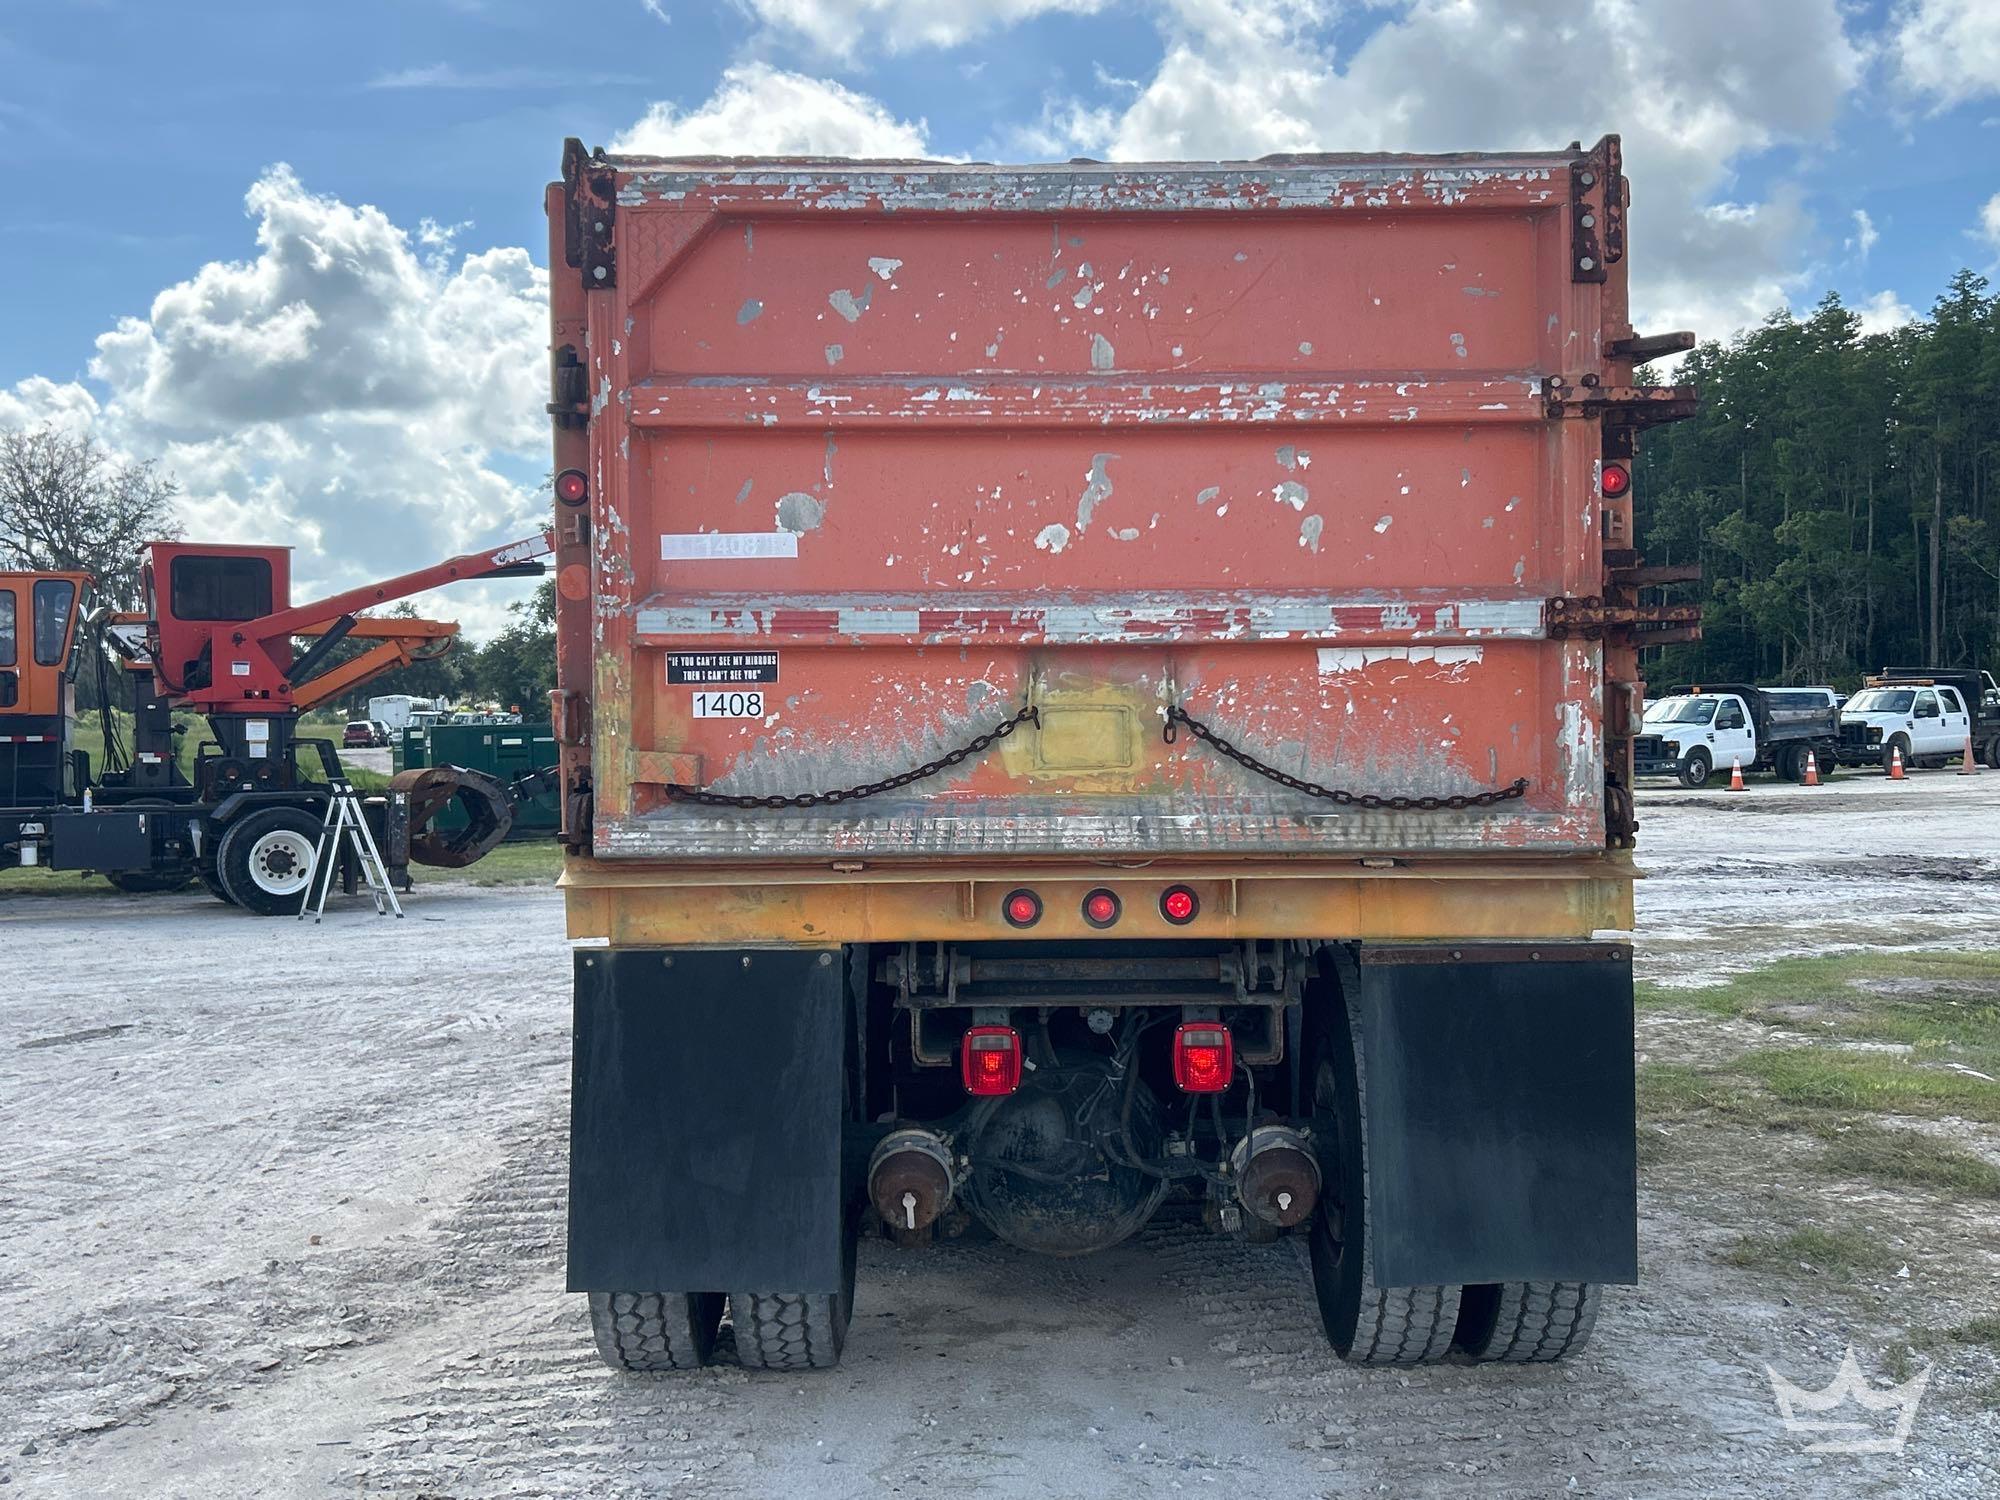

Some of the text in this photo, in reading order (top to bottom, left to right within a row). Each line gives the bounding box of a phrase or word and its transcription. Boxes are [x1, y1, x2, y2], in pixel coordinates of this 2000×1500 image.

[681, 656, 694, 667] YOU
[696, 656, 717, 667] CAN'T
[719, 656, 731, 666] SEE
[733, 655, 743, 666] MY
[745, 655, 777, 665] MIRRORS
[683, 670, 700, 681] THEN
[707, 670, 728, 681] CAN'T
[730, 670, 742, 680] SEE
[696, 693, 762, 717] 1408
